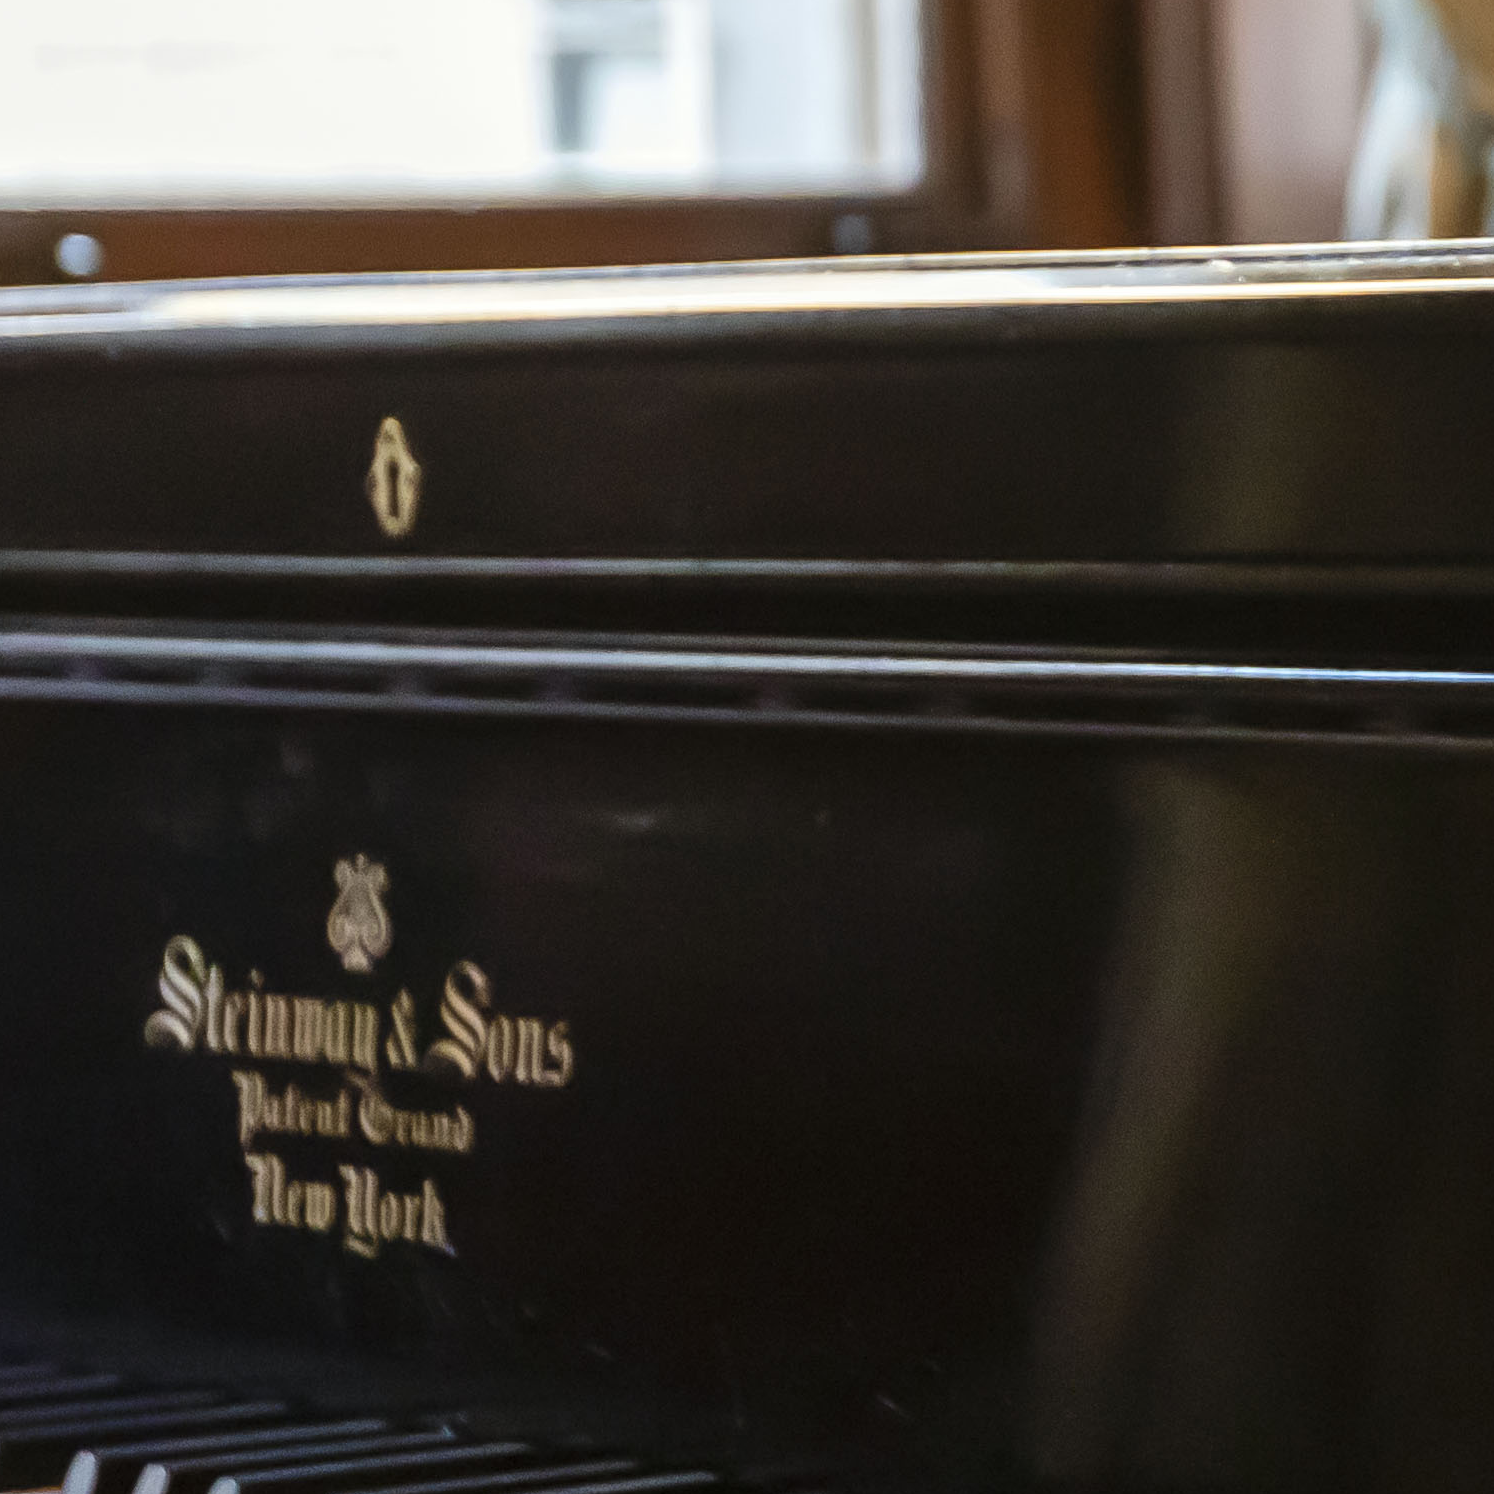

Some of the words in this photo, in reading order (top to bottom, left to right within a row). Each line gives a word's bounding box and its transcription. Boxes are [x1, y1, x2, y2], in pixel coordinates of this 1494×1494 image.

[144, 934, 380, 1087] Steinway
[385, 987, 416, 1070] &
[424, 960, 574, 1087] Sons
[231, 1069, 353, 1152] Patent
[245, 1152, 335, 1233] New
[339, 1164, 457, 1258] York
